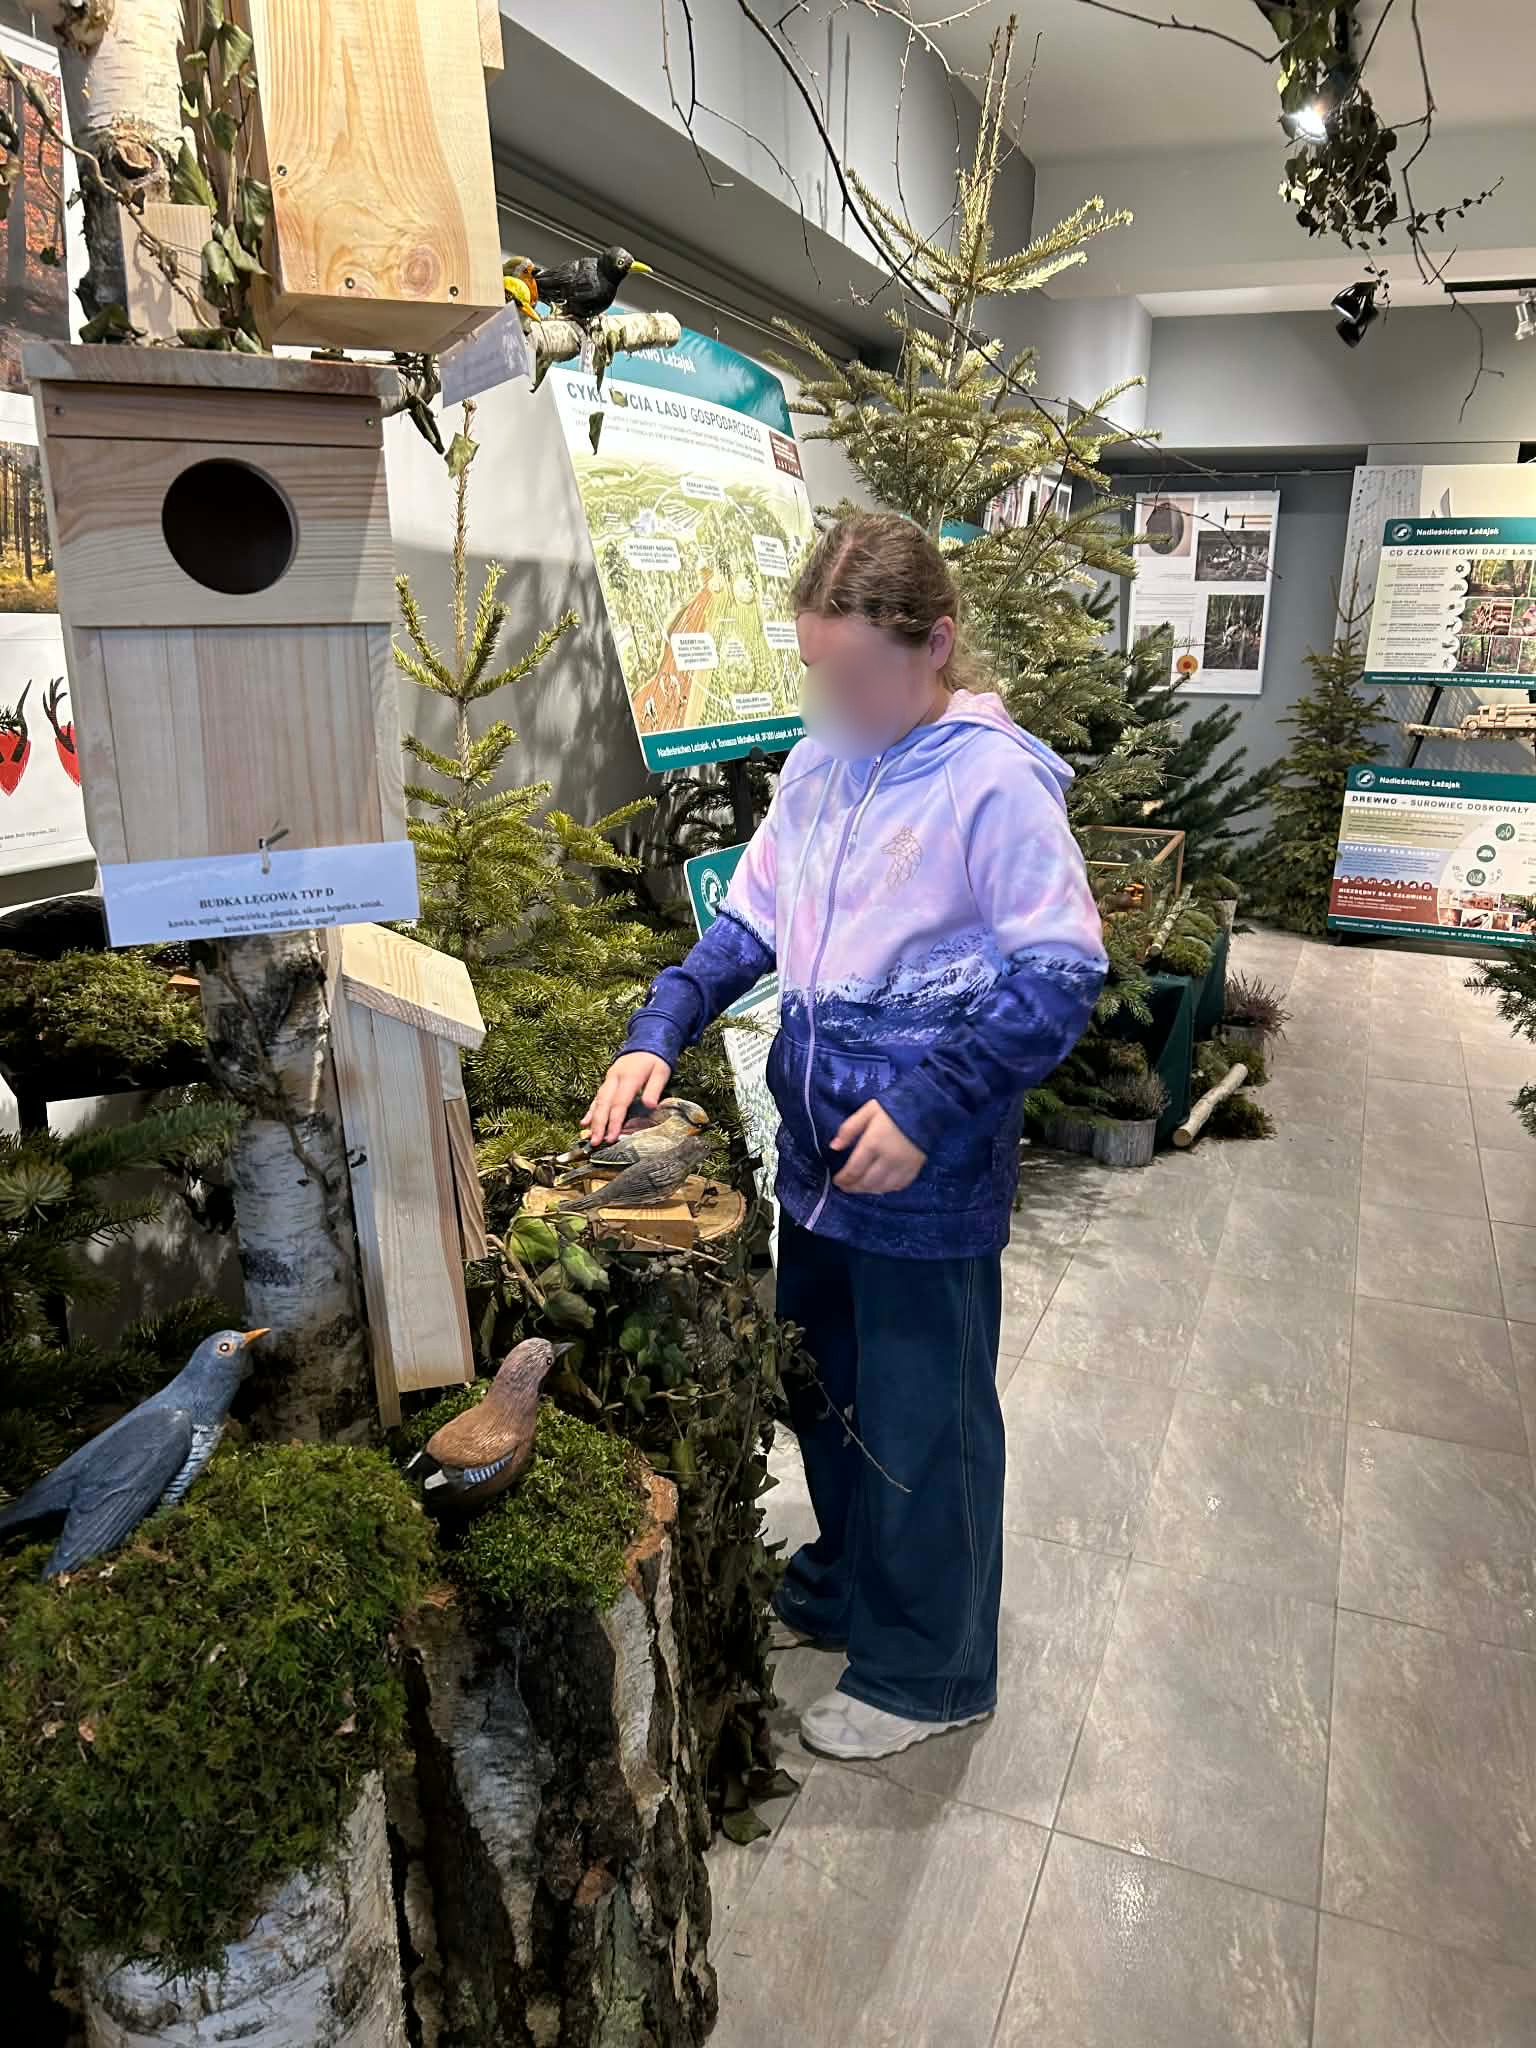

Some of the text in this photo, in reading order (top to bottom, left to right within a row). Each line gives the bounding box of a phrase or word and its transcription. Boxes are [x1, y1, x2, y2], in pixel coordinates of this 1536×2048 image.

[567, 382, 607, 404] CYKL
[656, 400, 687, 419] LASU
[691, 407, 761, 443] GOSPODARCZEGO
[1416, 527, 1499, 537] Nadleśnictwo Leżajsk
[1389, 548, 1536, 557] CO CZŁOWIEKOWI DAJE LAS
[1379, 776, 1460, 789] Nadleśnictwo Leżajsk
[1352, 795, 1397, 805] DREWNO
[1410, 799, 1463, 810] SUROWIEC
[1467, 802, 1530, 814] DOSKONAŁY
[199, 887, 335, 910] BUDKA LĘGOWA TYP D
